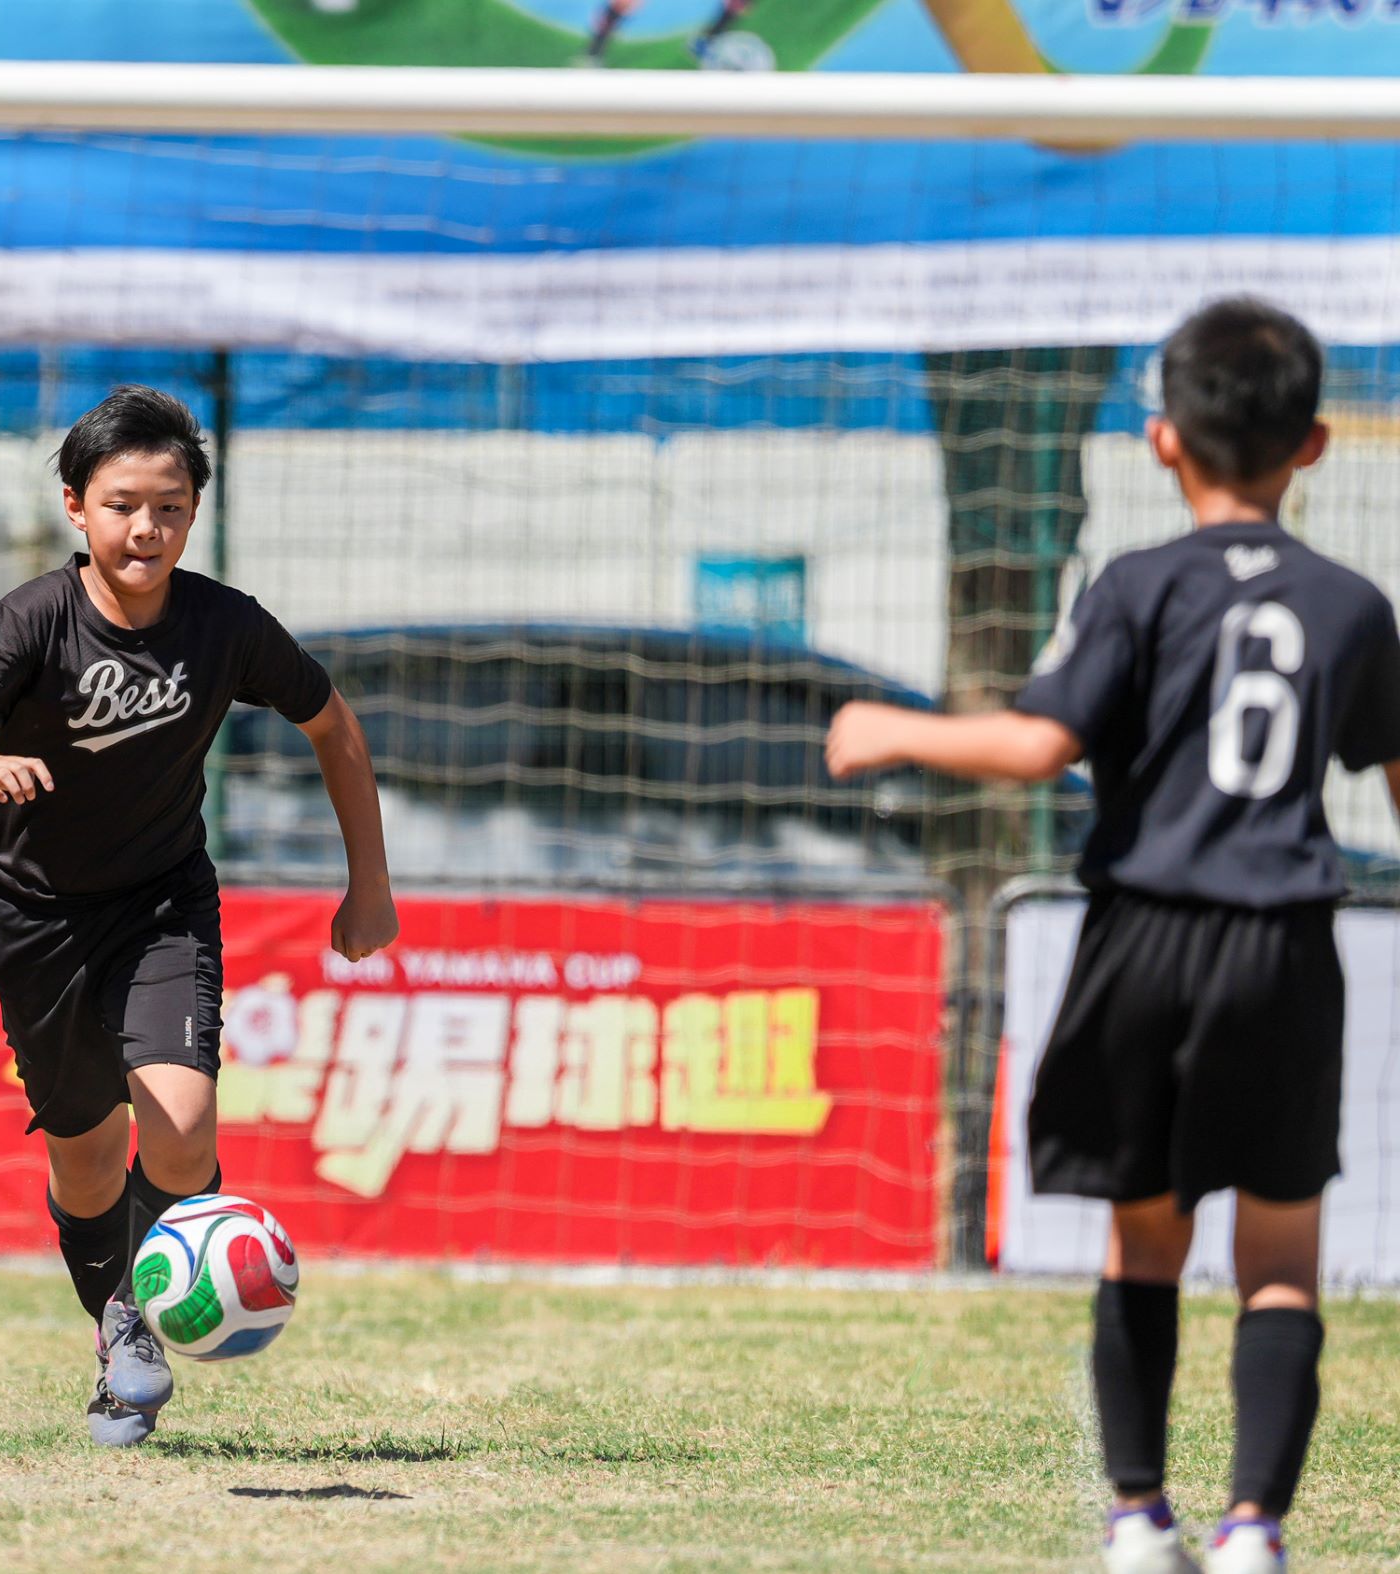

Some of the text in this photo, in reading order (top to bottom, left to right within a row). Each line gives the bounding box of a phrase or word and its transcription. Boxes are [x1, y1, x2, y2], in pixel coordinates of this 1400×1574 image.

[67, 659, 191, 752] Best
[1207, 601, 1306, 800] 6
[401, 947, 558, 986] YAMAHA
[564, 951, 642, 990] CUP
